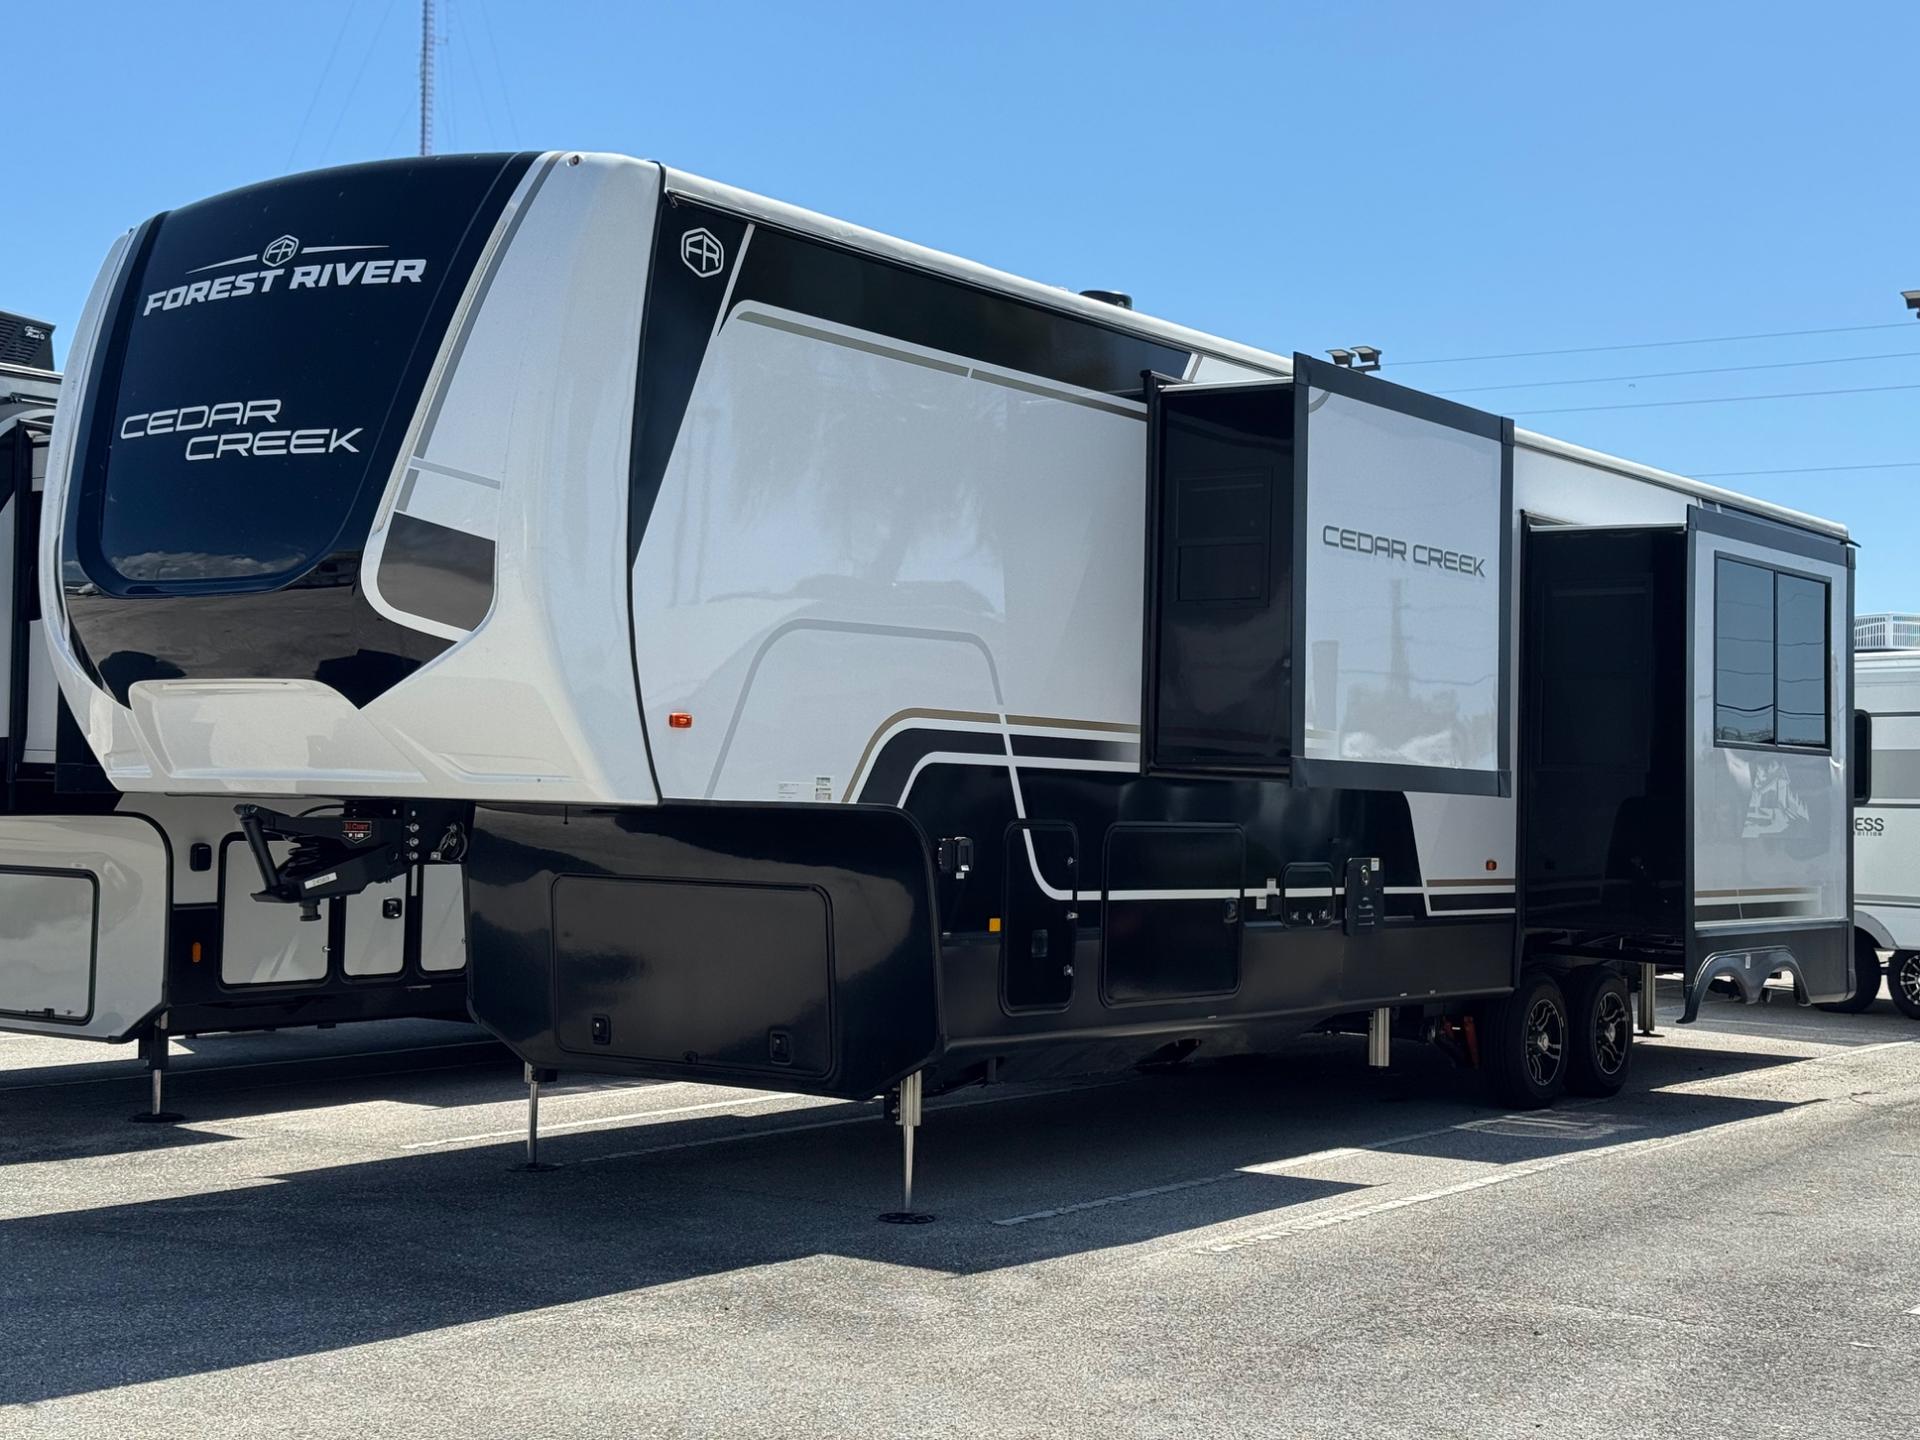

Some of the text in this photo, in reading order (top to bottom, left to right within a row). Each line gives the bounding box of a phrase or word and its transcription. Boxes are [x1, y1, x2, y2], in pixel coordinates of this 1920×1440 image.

[143, 259, 427, 317] FOREST RIVER
[120, 399, 282, 440] CEDAR
[185, 428, 364, 461] CREEK
[1322, 525, 1486, 578] CEDAR CREEK
[1855, 817, 1884, 831] ESS
